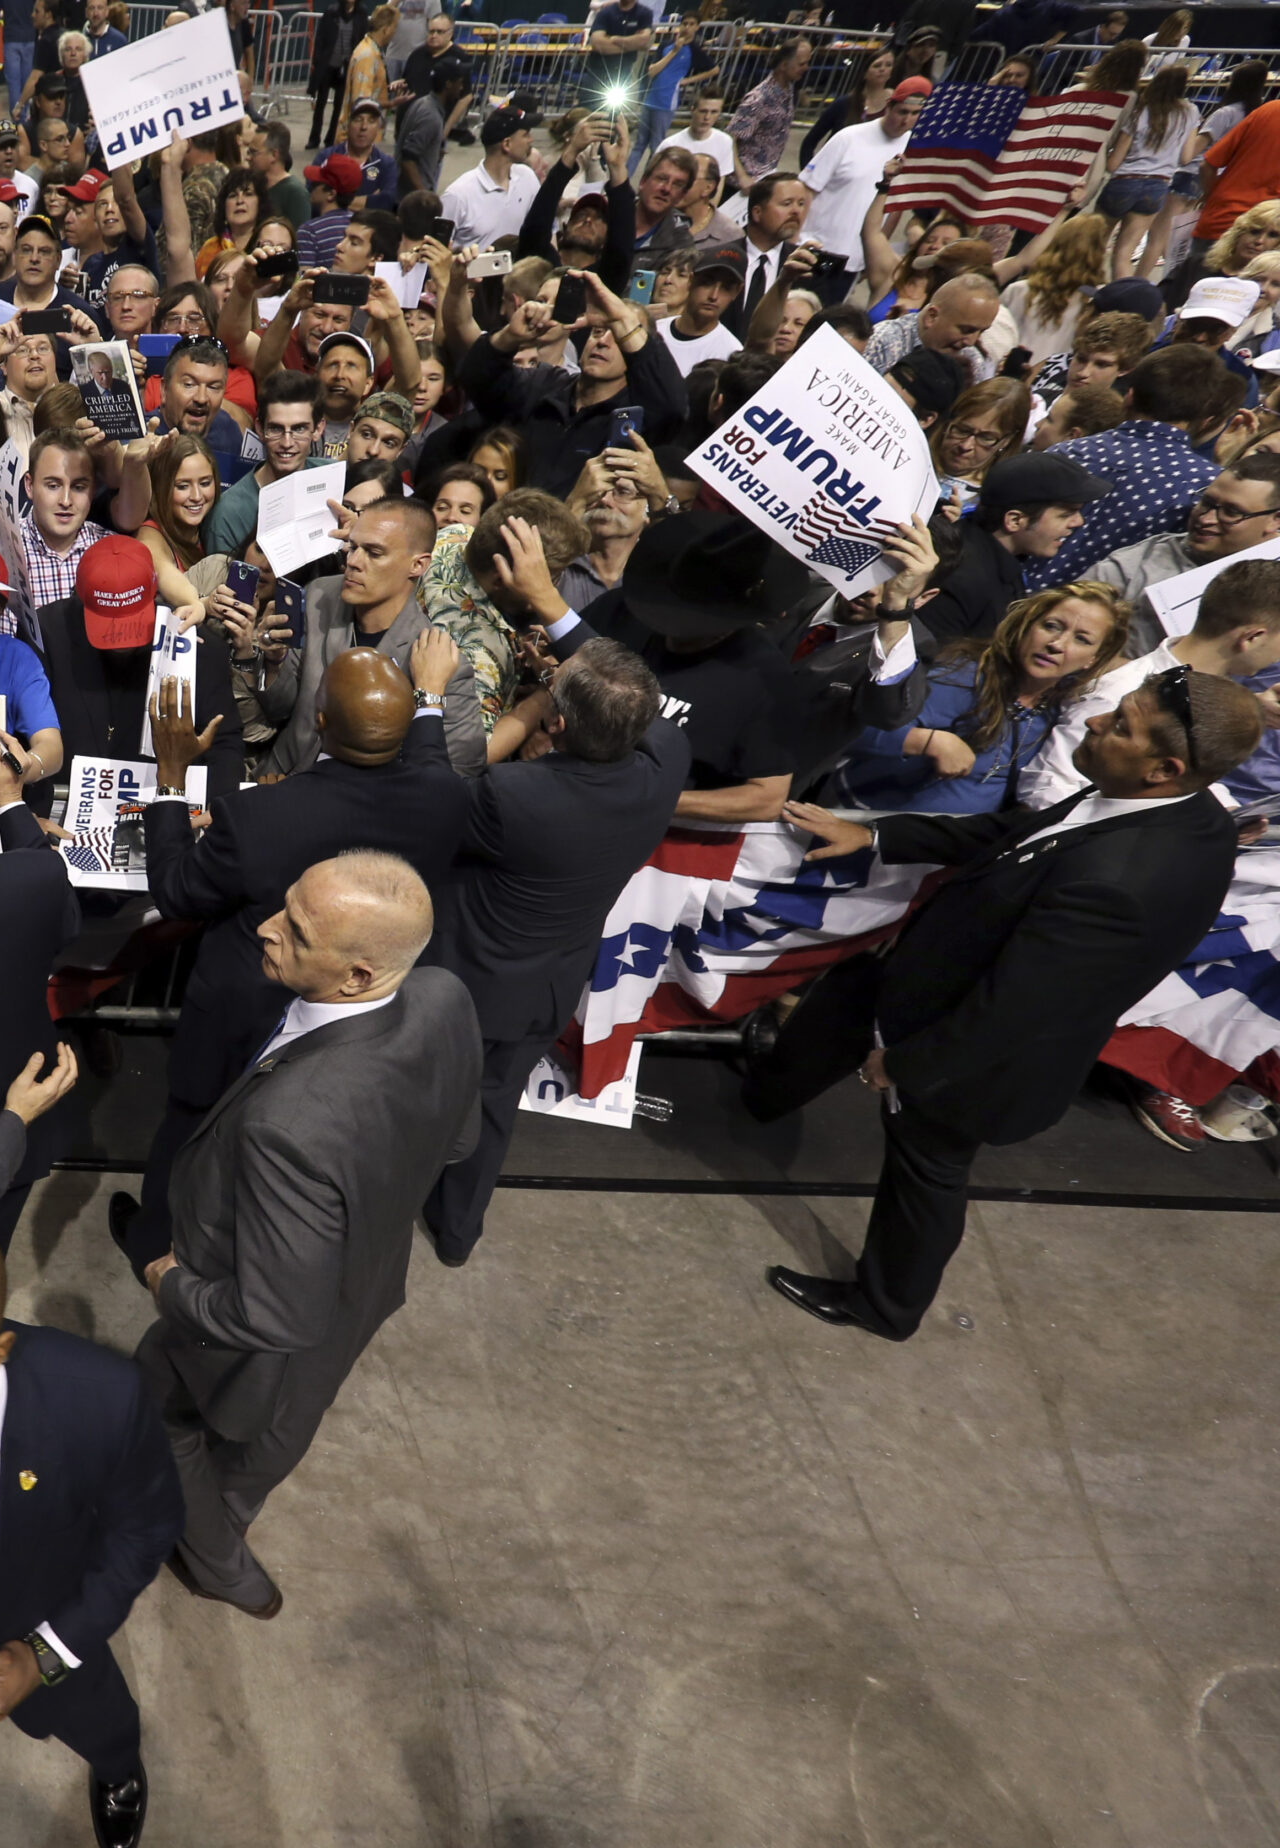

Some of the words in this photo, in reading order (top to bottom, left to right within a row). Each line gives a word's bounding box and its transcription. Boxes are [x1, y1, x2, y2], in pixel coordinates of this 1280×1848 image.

[164, 79, 203, 100] AMERICA
[205, 69, 233, 85] MAKE
[107, 89, 239, 155] TRUMP
[133, 97, 161, 115] GREAT
[85, 394, 131, 405] CRIPPLED
[837, 368, 877, 407] AGAIN!
[89, 403, 132, 414] AMERICA
[806, 367, 911, 471] AMERICA
[875, 405, 909, 439] GREAT
[723, 425, 767, 466] FOR
[824, 423, 860, 456] MAKE
[743, 405, 882, 527] TRUMP
[702, 443, 799, 531] VETERANS
[93, 589, 114, 600] MAKE
[114, 585, 145, 600] AMERICA
[97, 598, 121, 608] GREAT
[121, 594, 142, 607] AGAIN
[98, 769, 114, 799] FOR
[75, 767, 97, 835] VETERANS
